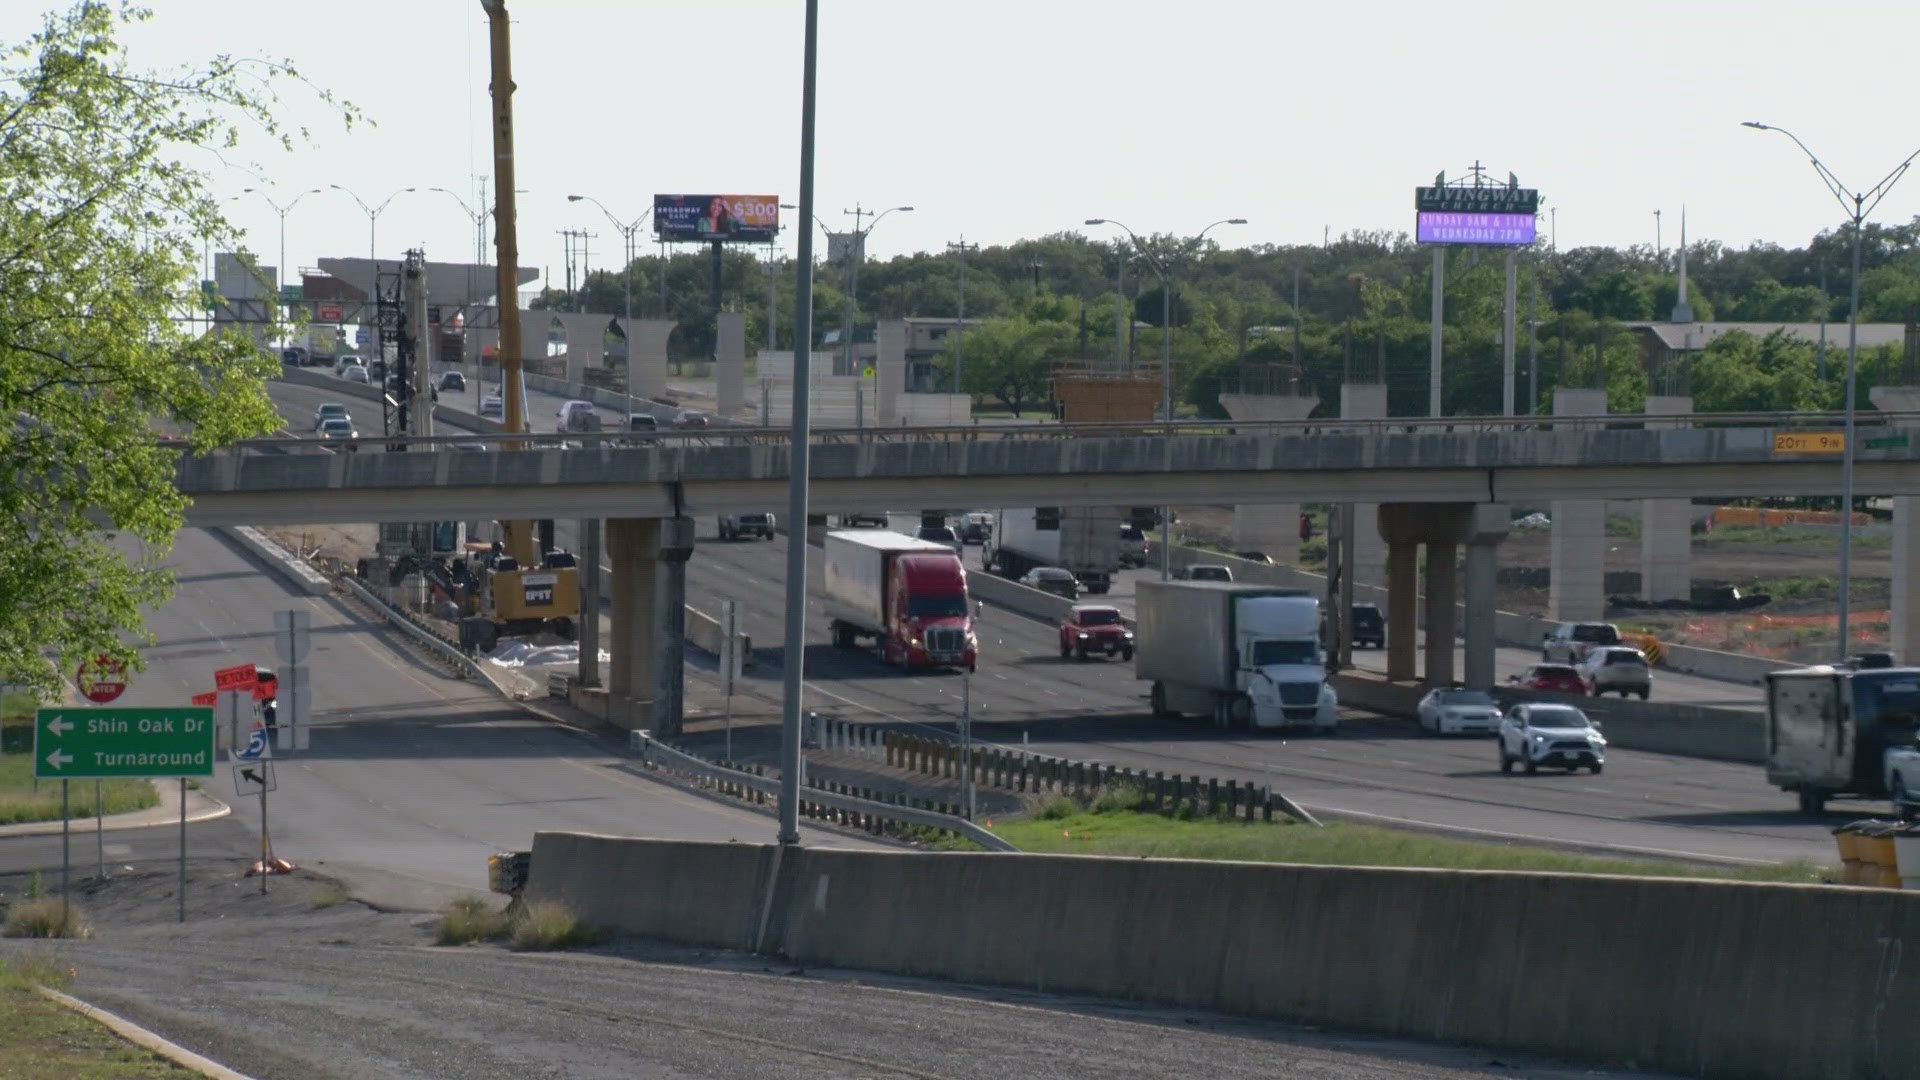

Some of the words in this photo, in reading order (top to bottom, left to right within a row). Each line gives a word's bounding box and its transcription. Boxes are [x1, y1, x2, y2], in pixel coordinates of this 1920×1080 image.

[734, 202, 777, 217] $300
[1441, 201, 1515, 211] CHURCH
[1422, 214, 1463, 226] SUNDAY
[1467, 215, 1488, 227] 9AM
[1493, 216, 1500, 227] &
[1506, 216, 1533, 228] 11AM
[1432, 227, 1496, 240] WEDNESDAY
[1500, 228, 1522, 240] 7PM
[217, 669, 255, 687] DETOUR
[88, 718, 128, 733] Shin
[138, 718, 174, 733] Oak
[185, 718, 204, 732] Dr
[250, 730, 265, 753] 5
[95, 750, 205, 766] Turnaround
